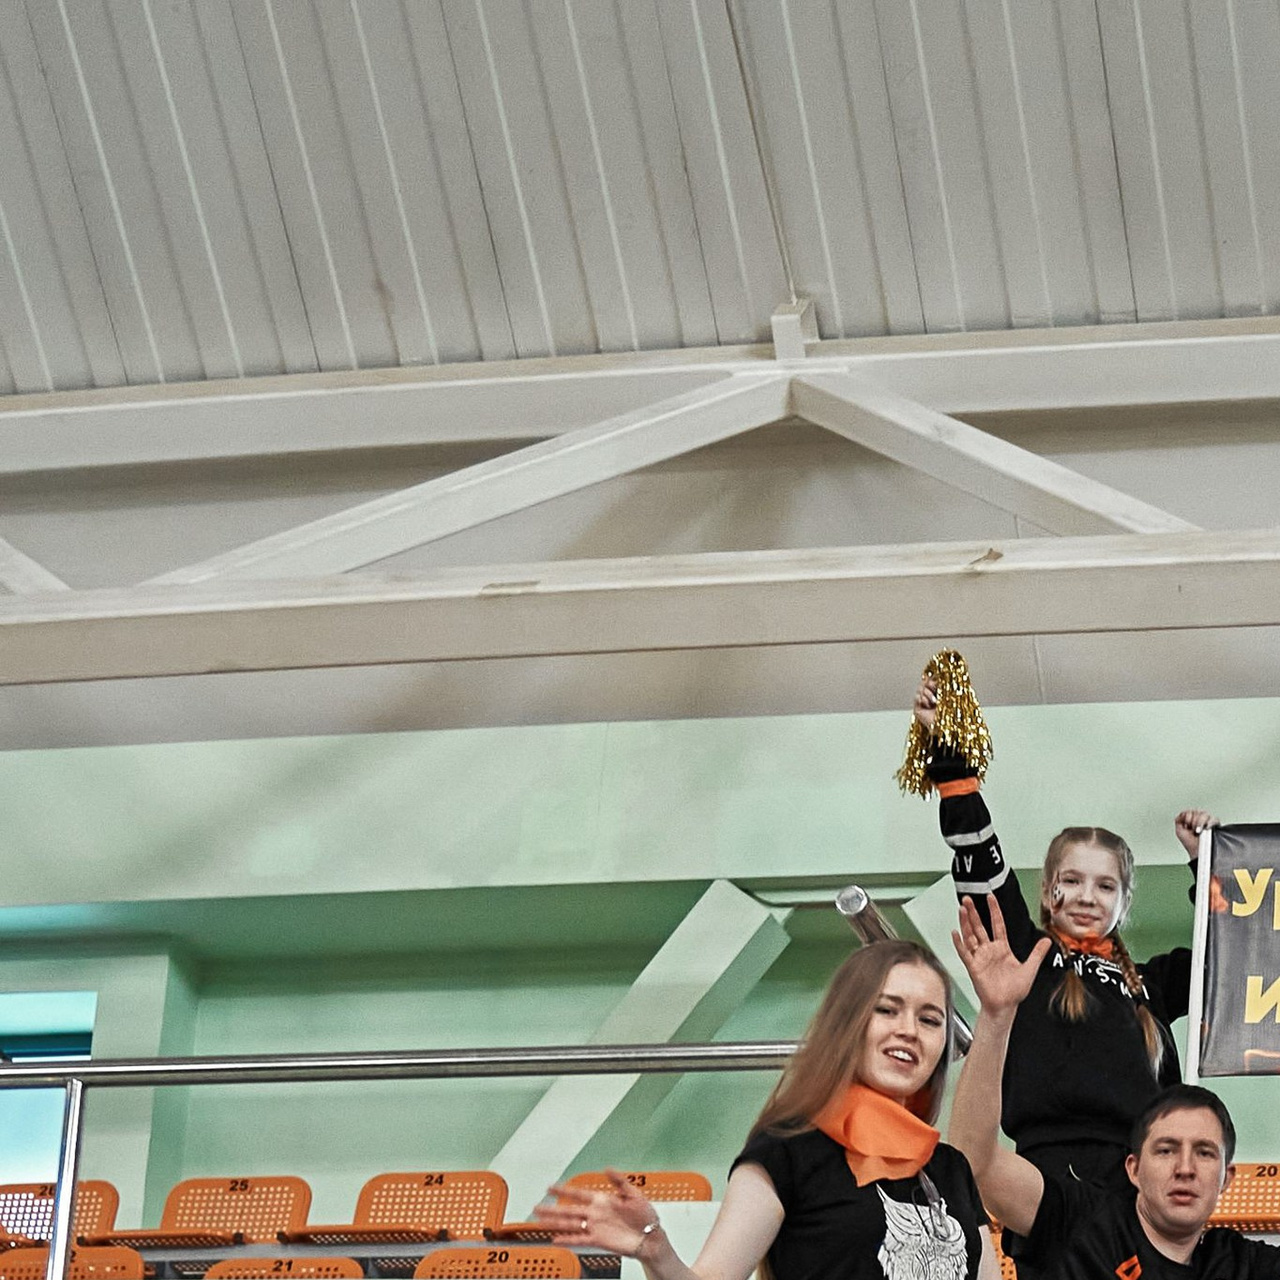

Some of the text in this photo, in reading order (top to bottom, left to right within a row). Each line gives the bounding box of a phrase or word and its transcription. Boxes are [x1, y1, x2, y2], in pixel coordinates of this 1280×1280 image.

[1255, 1164, 1279, 1178] 20
[228, 1178, 250, 1193] 25
[422, 1173, 446, 1188] 24
[626, 1174, 647, 1187] 23
[486, 1250, 510, 1264] 20
[271, 1258, 295, 1273] 21
